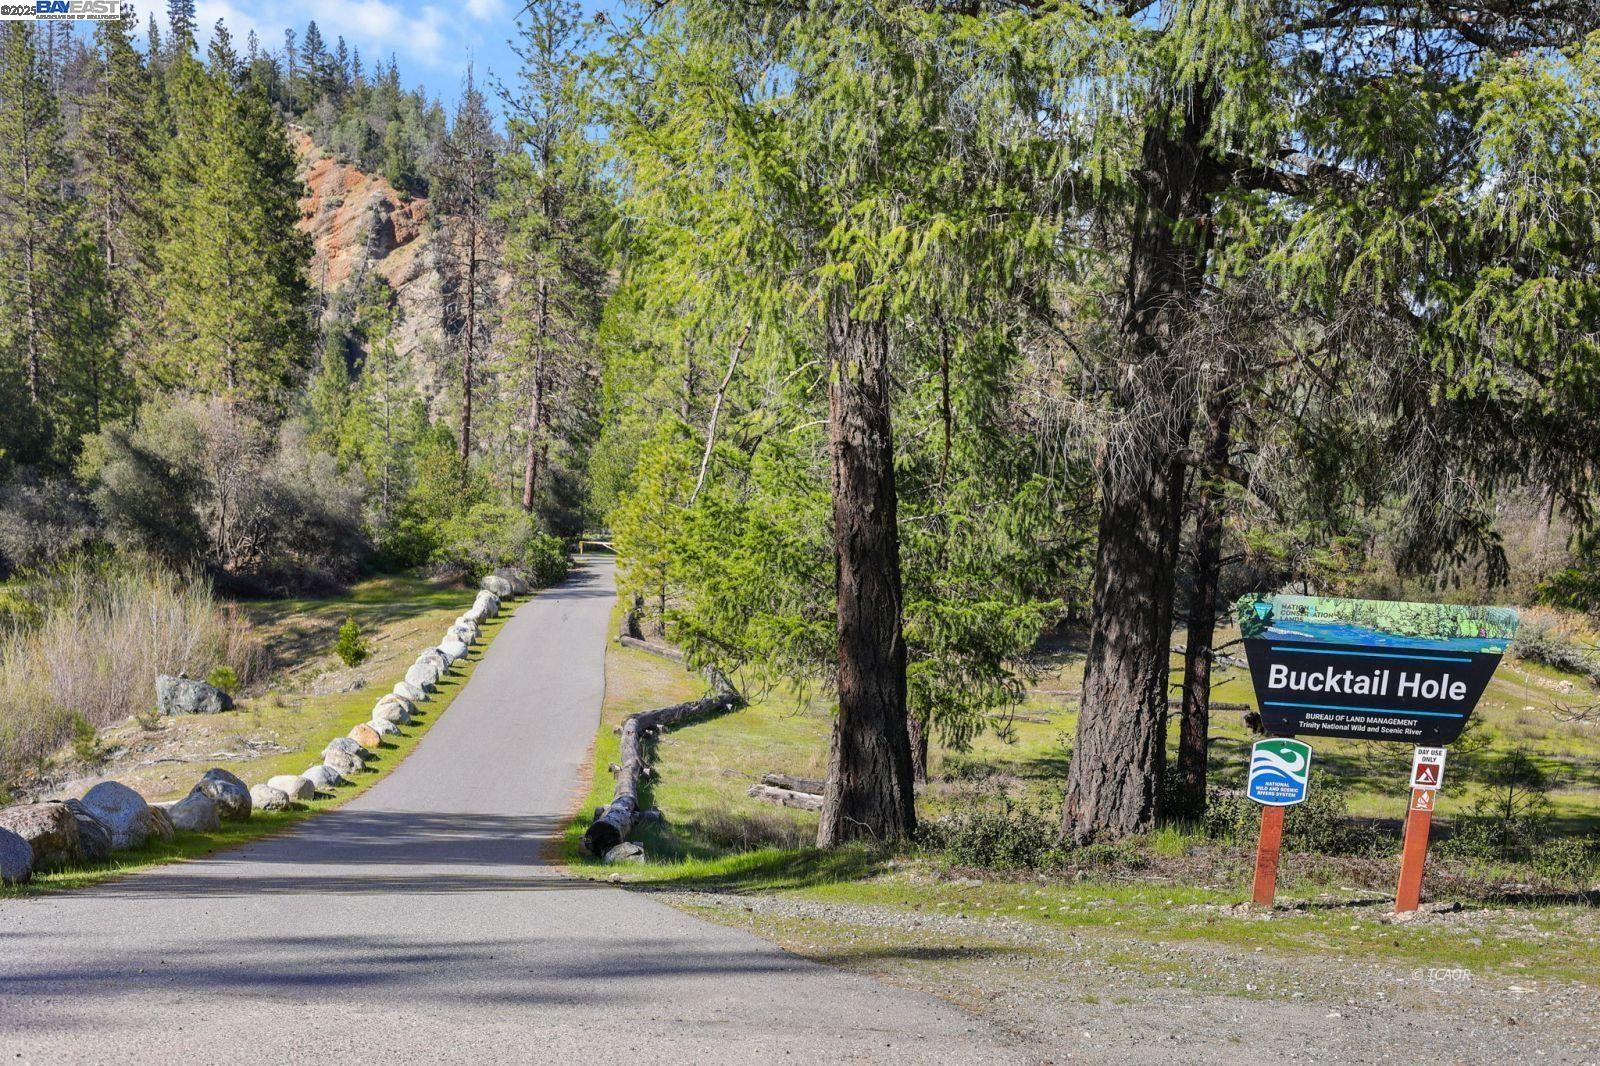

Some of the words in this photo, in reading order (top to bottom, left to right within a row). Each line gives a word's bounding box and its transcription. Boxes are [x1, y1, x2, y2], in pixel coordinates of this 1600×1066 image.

[1268, 664, 1389, 695] Bucktail
[1397, 672, 1467, 701] Hole
[1306, 713, 1334, 721] BUREAU
[1346, 715, 1365, 723] LAND
[1367, 716, 1418, 726] MANAGEMENT
[1299, 721, 1320, 730] Trinity
[1322, 722, 1350, 731] National
[1351, 724, 1366, 732] Wild
[1367, 725, 1379, 733] and
[1405, 728, 1423, 736] River
